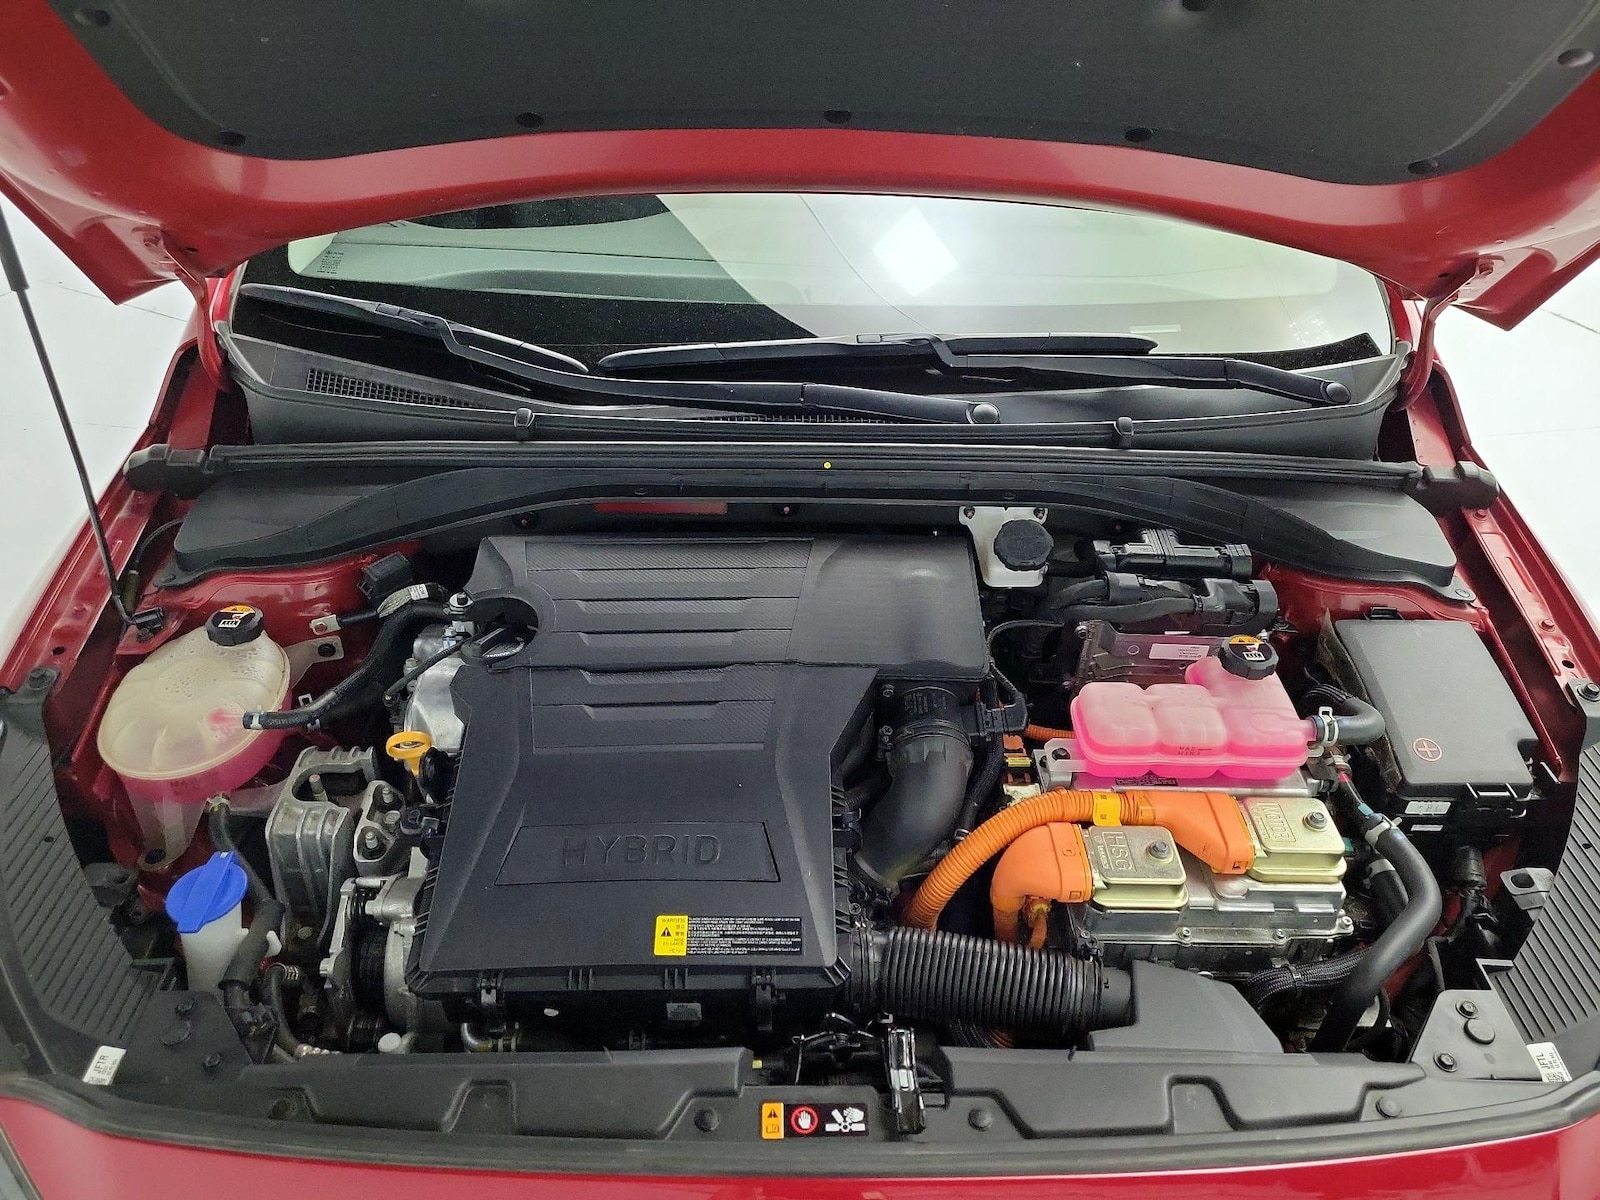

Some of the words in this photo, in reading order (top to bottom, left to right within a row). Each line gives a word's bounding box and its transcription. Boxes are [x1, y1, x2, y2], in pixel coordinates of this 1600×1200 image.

[1261, 806, 1290, 839] MOTOR
[562, 834, 721, 866] HYBRID
[1106, 835, 1133, 870] HSG
